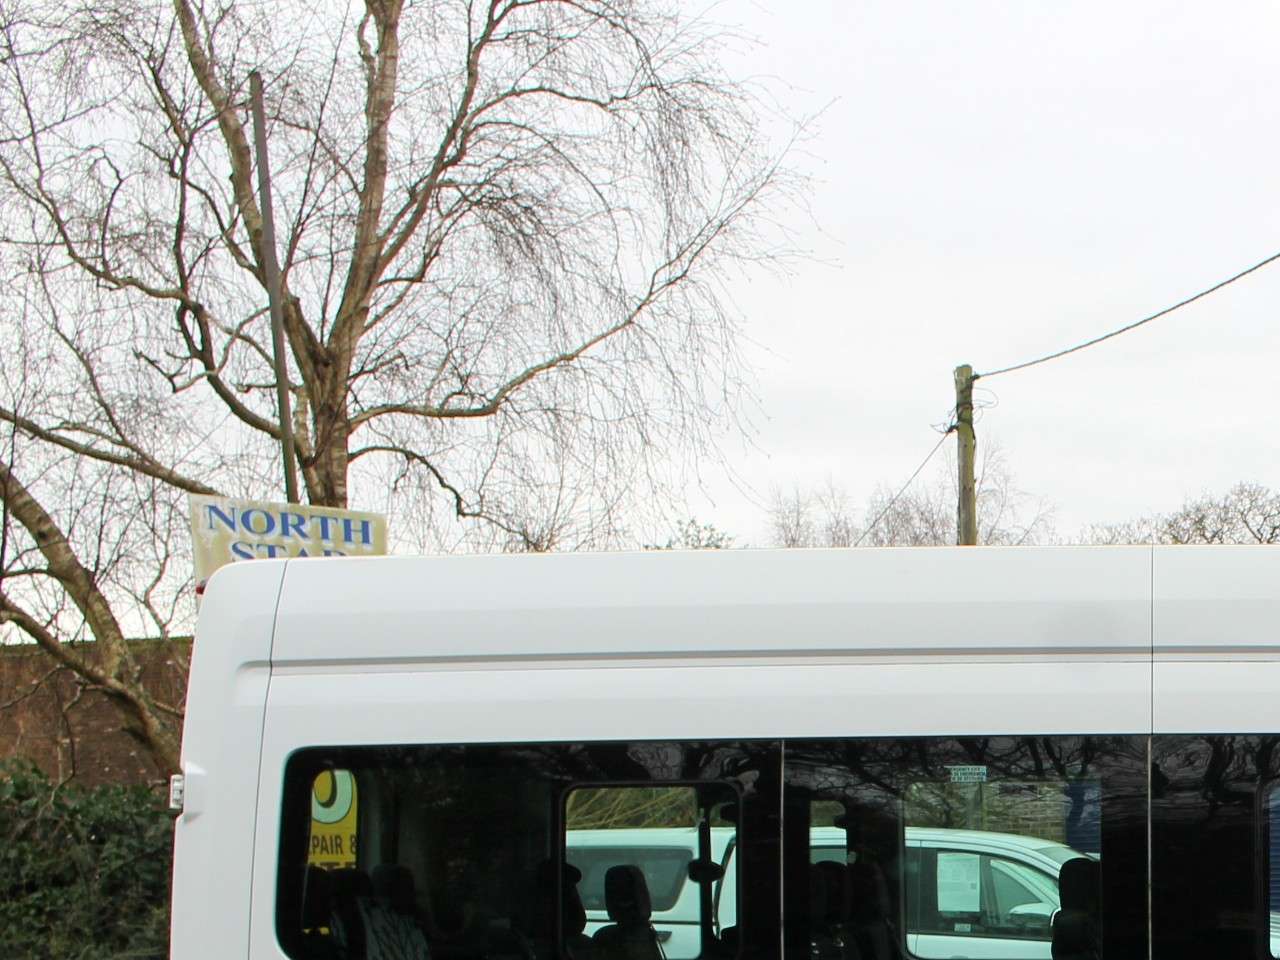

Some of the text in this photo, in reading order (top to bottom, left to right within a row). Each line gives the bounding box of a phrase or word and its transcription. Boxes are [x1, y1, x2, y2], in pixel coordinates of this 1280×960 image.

[206, 504, 371, 544] NORTH
[231, 541, 347, 559] ST
[309, 835, 344, 855] PAIR
